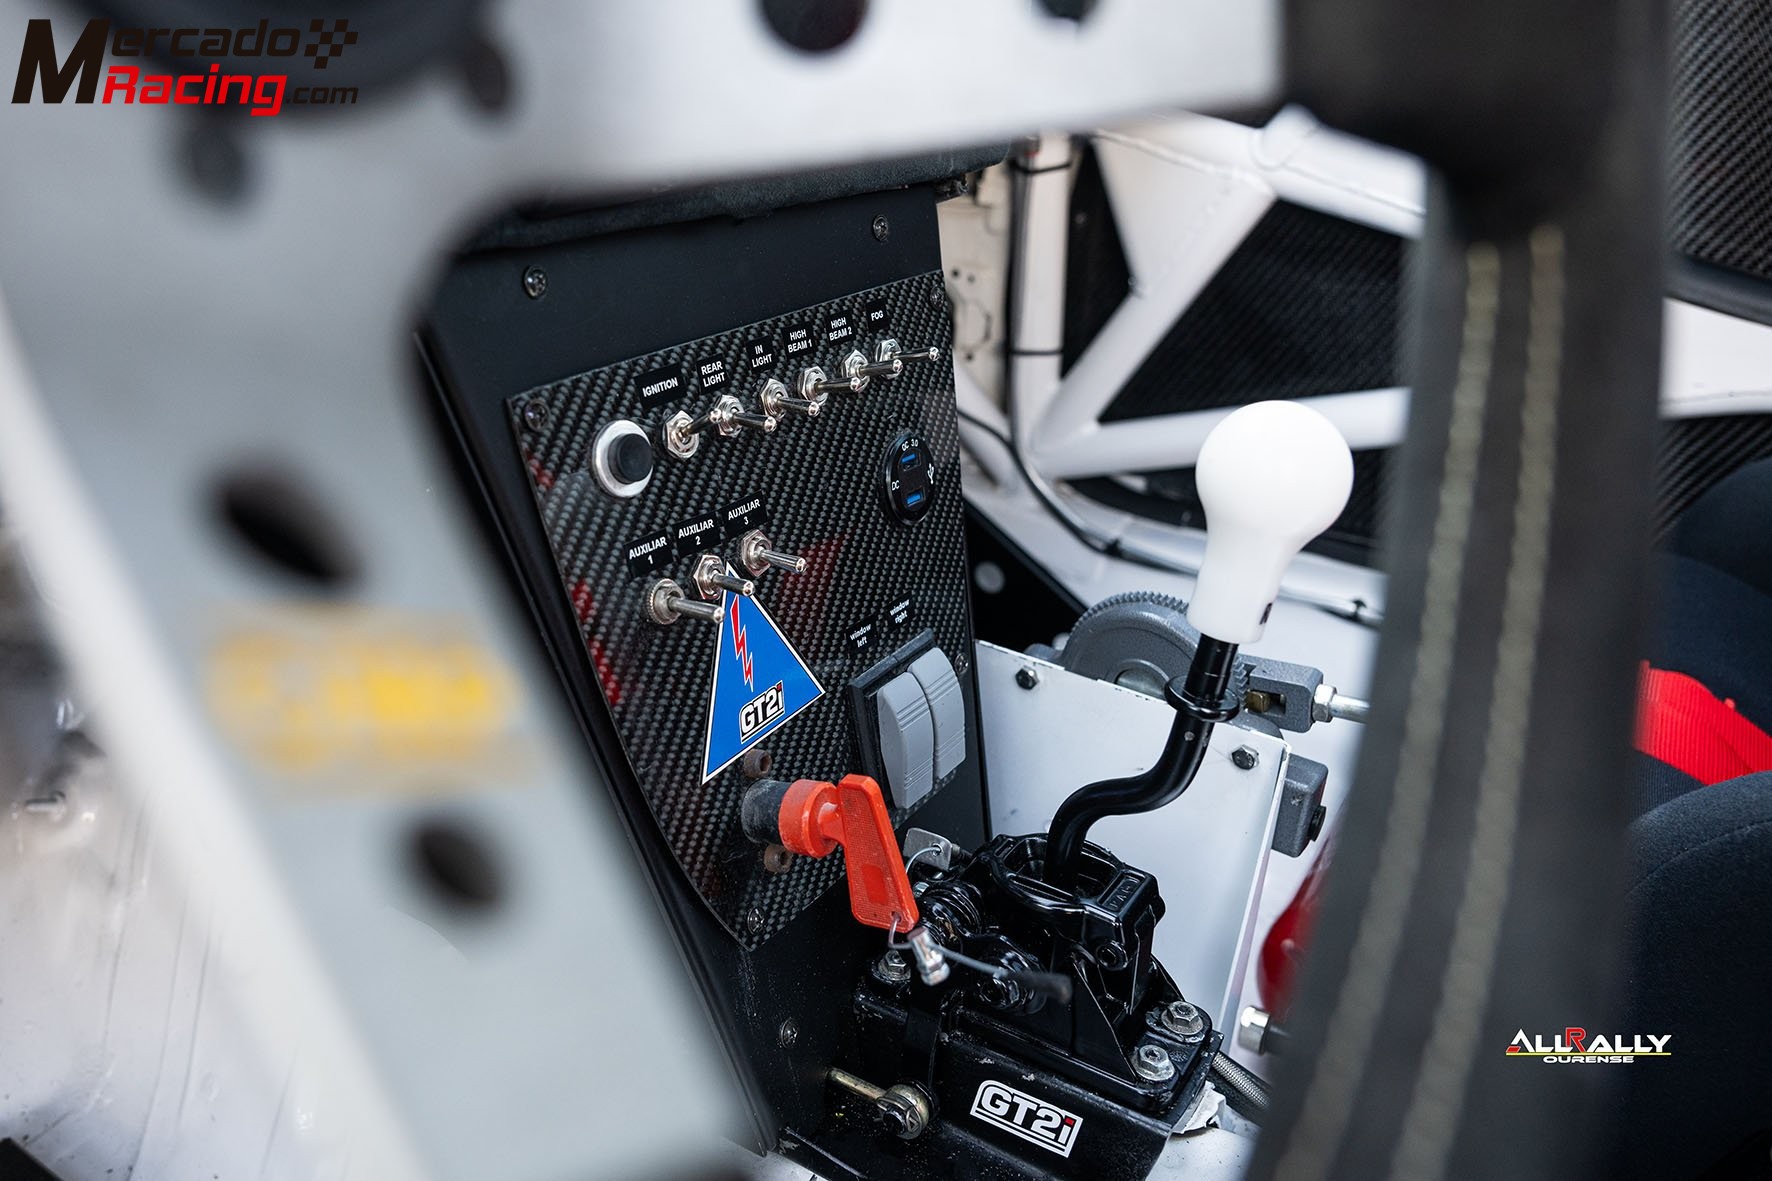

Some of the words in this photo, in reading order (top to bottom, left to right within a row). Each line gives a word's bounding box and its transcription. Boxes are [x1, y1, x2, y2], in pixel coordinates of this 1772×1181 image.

[870, 310, 884, 321] FOG
[831, 317, 847, 329] HIGH
[789, 329, 807, 341] HIGH
[829, 328, 847, 341] BEAM
[754, 345, 763, 354] IN
[787, 340, 807, 353] BEAM
[701, 360, 723, 376] REAR
[752, 354, 773, 368] LIGHT
[703, 372, 725, 387] LIGHT
[642, 377, 678, 397] IGNITION
[728, 499, 761, 521] AUXILIAR
[743, 516, 749, 525] 3
[678, 519, 714, 539] AUXILIAR
[695, 535, 701, 545] 2
[628, 536, 667, 560] AUXILIAR
[890, 599, 909, 616] window
[895, 610, 908, 624] right
[850, 624, 871, 640] window
[857, 636, 867, 648] left
[740, 681, 784, 735] GT2i
[981, 1085, 1075, 1145] GT2i
